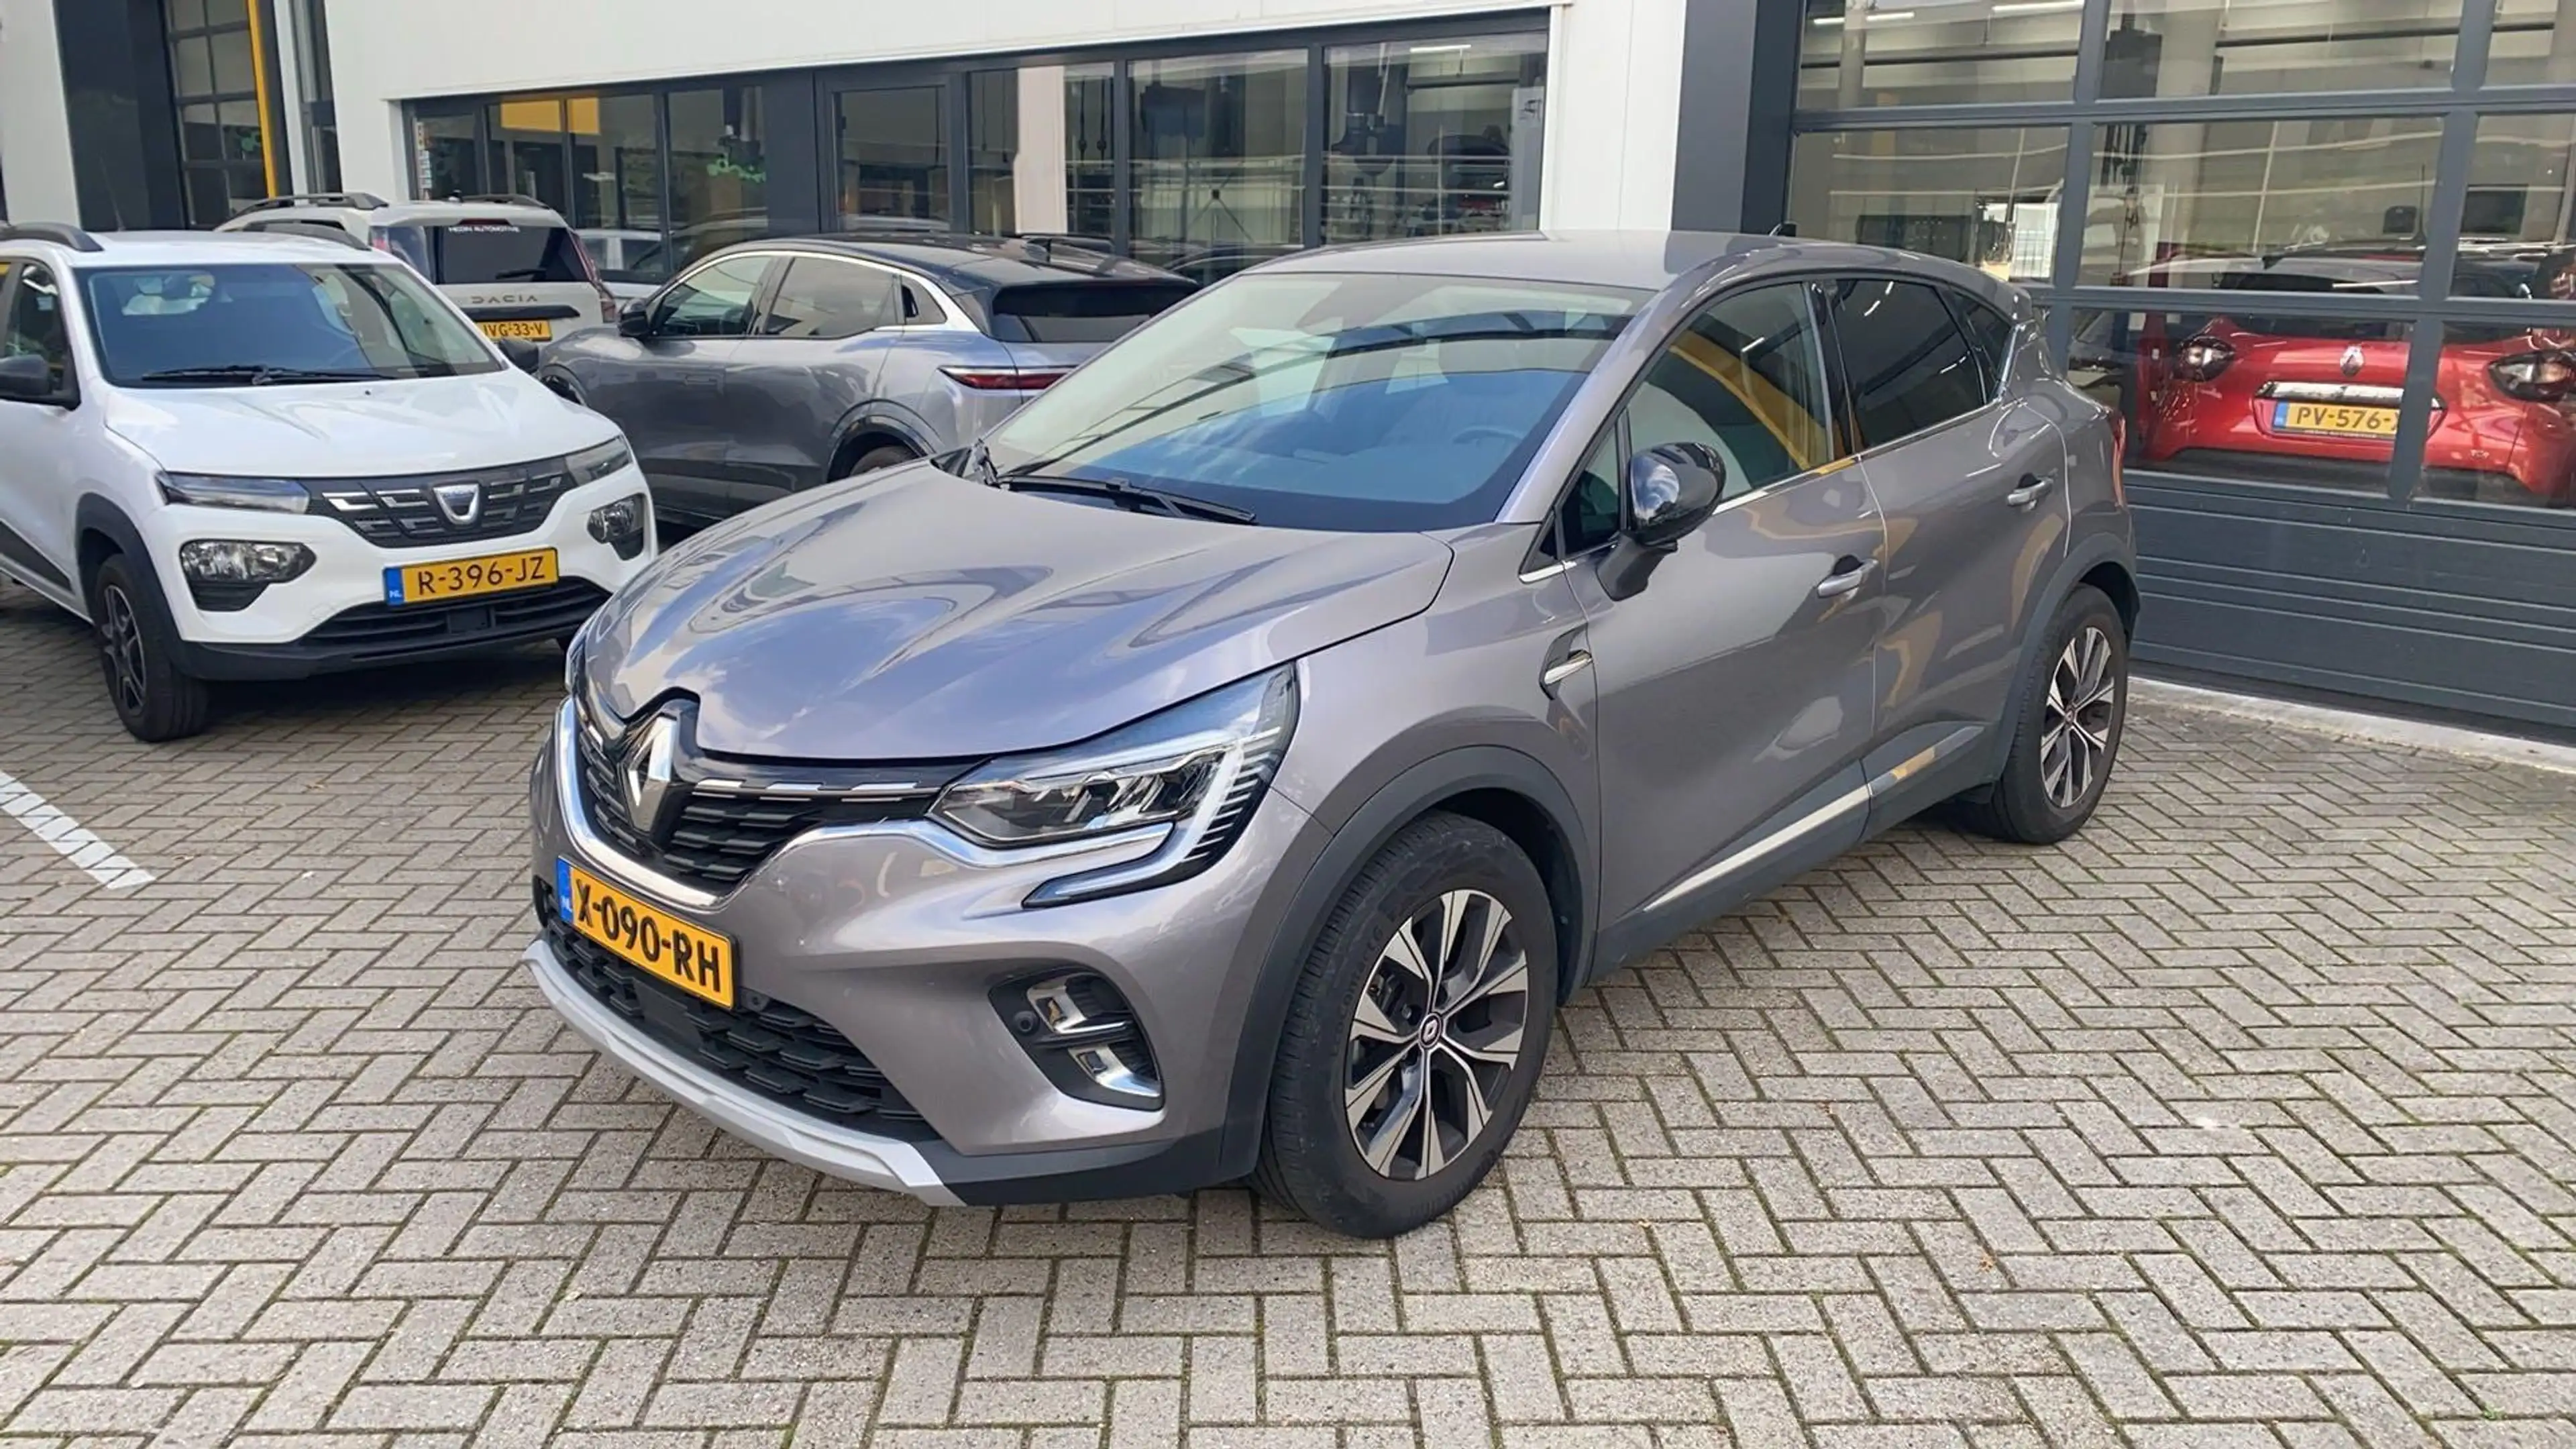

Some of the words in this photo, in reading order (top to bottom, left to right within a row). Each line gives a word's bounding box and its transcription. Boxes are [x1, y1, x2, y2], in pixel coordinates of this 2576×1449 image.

[470, 294, 538, 304] DACIA
[417, 555, 546, 596] R-396-JZ
[575, 878, 721, 993] X-090-RH
